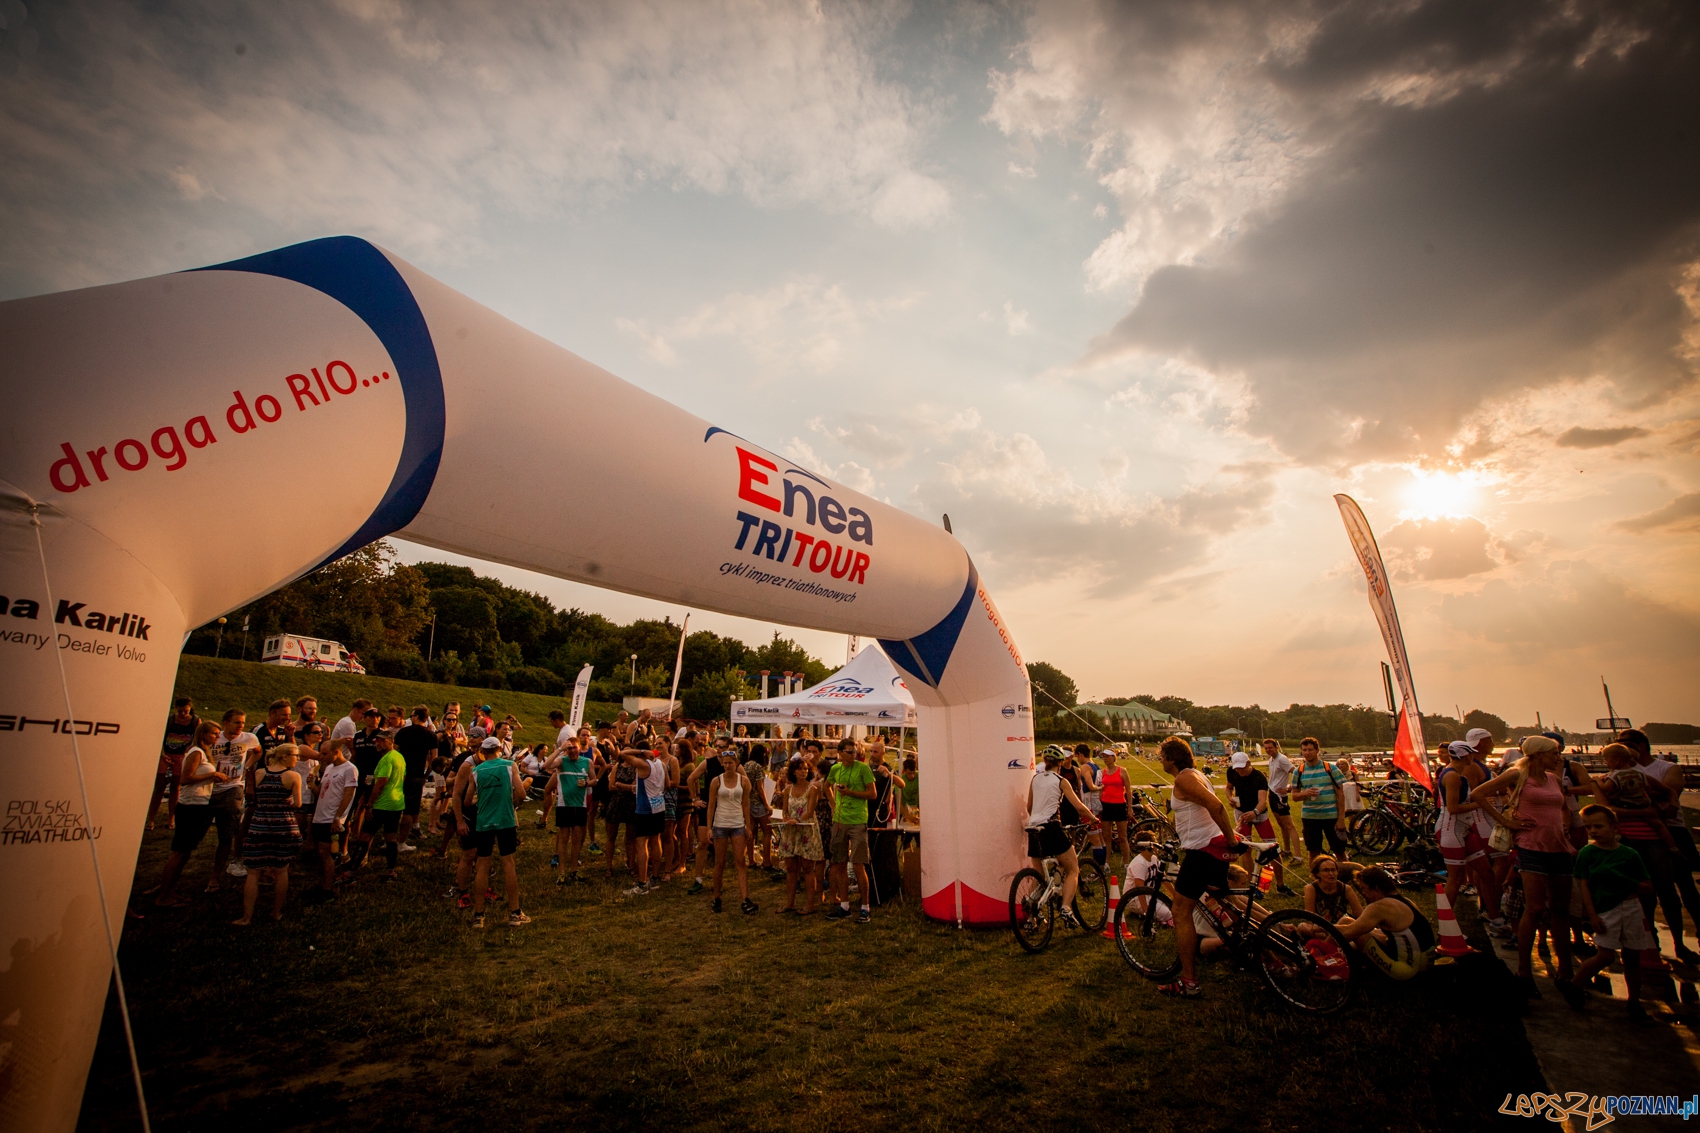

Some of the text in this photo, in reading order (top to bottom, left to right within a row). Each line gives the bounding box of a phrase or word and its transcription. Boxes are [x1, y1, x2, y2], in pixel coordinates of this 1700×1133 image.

[49, 360, 390, 493] droga do RIO...
[735, 446, 873, 546] Enea
[734, 510, 870, 585] TRITOUR
[719, 561, 857, 603] cykl imprez triathlonowych
[54, 599, 152, 641] Karlik
[978, 589, 999, 627] droga
[999, 628, 1009, 644] do
[57, 633, 113, 656] Dealer
[117, 644, 147, 663] Volvo
[813, 685, 874, 694] Enea
[7, 800, 71, 815] POLSKI
[0, 826, 102, 845] TRIATHLONU
